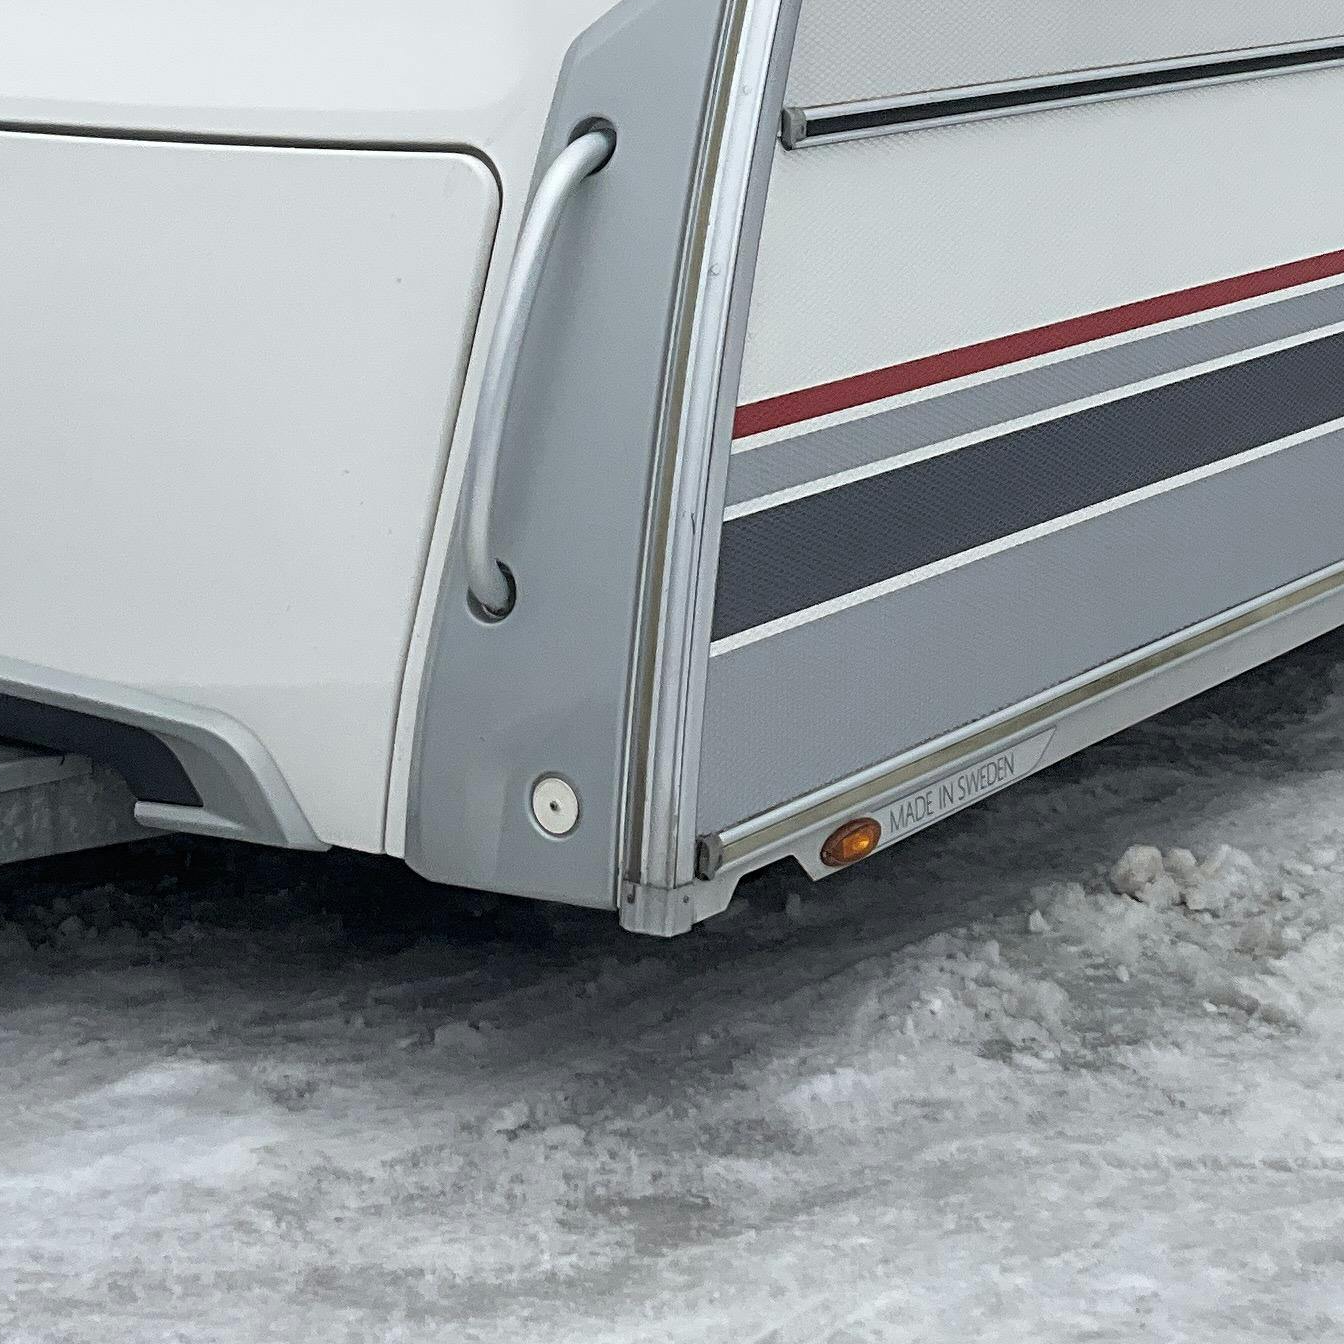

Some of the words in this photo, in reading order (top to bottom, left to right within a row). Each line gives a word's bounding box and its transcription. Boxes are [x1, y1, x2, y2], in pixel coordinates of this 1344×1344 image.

[889, 790, 934, 833] MADE
[939, 783, 955, 810] IN
[957, 752, 1016, 801] SWEDEN
